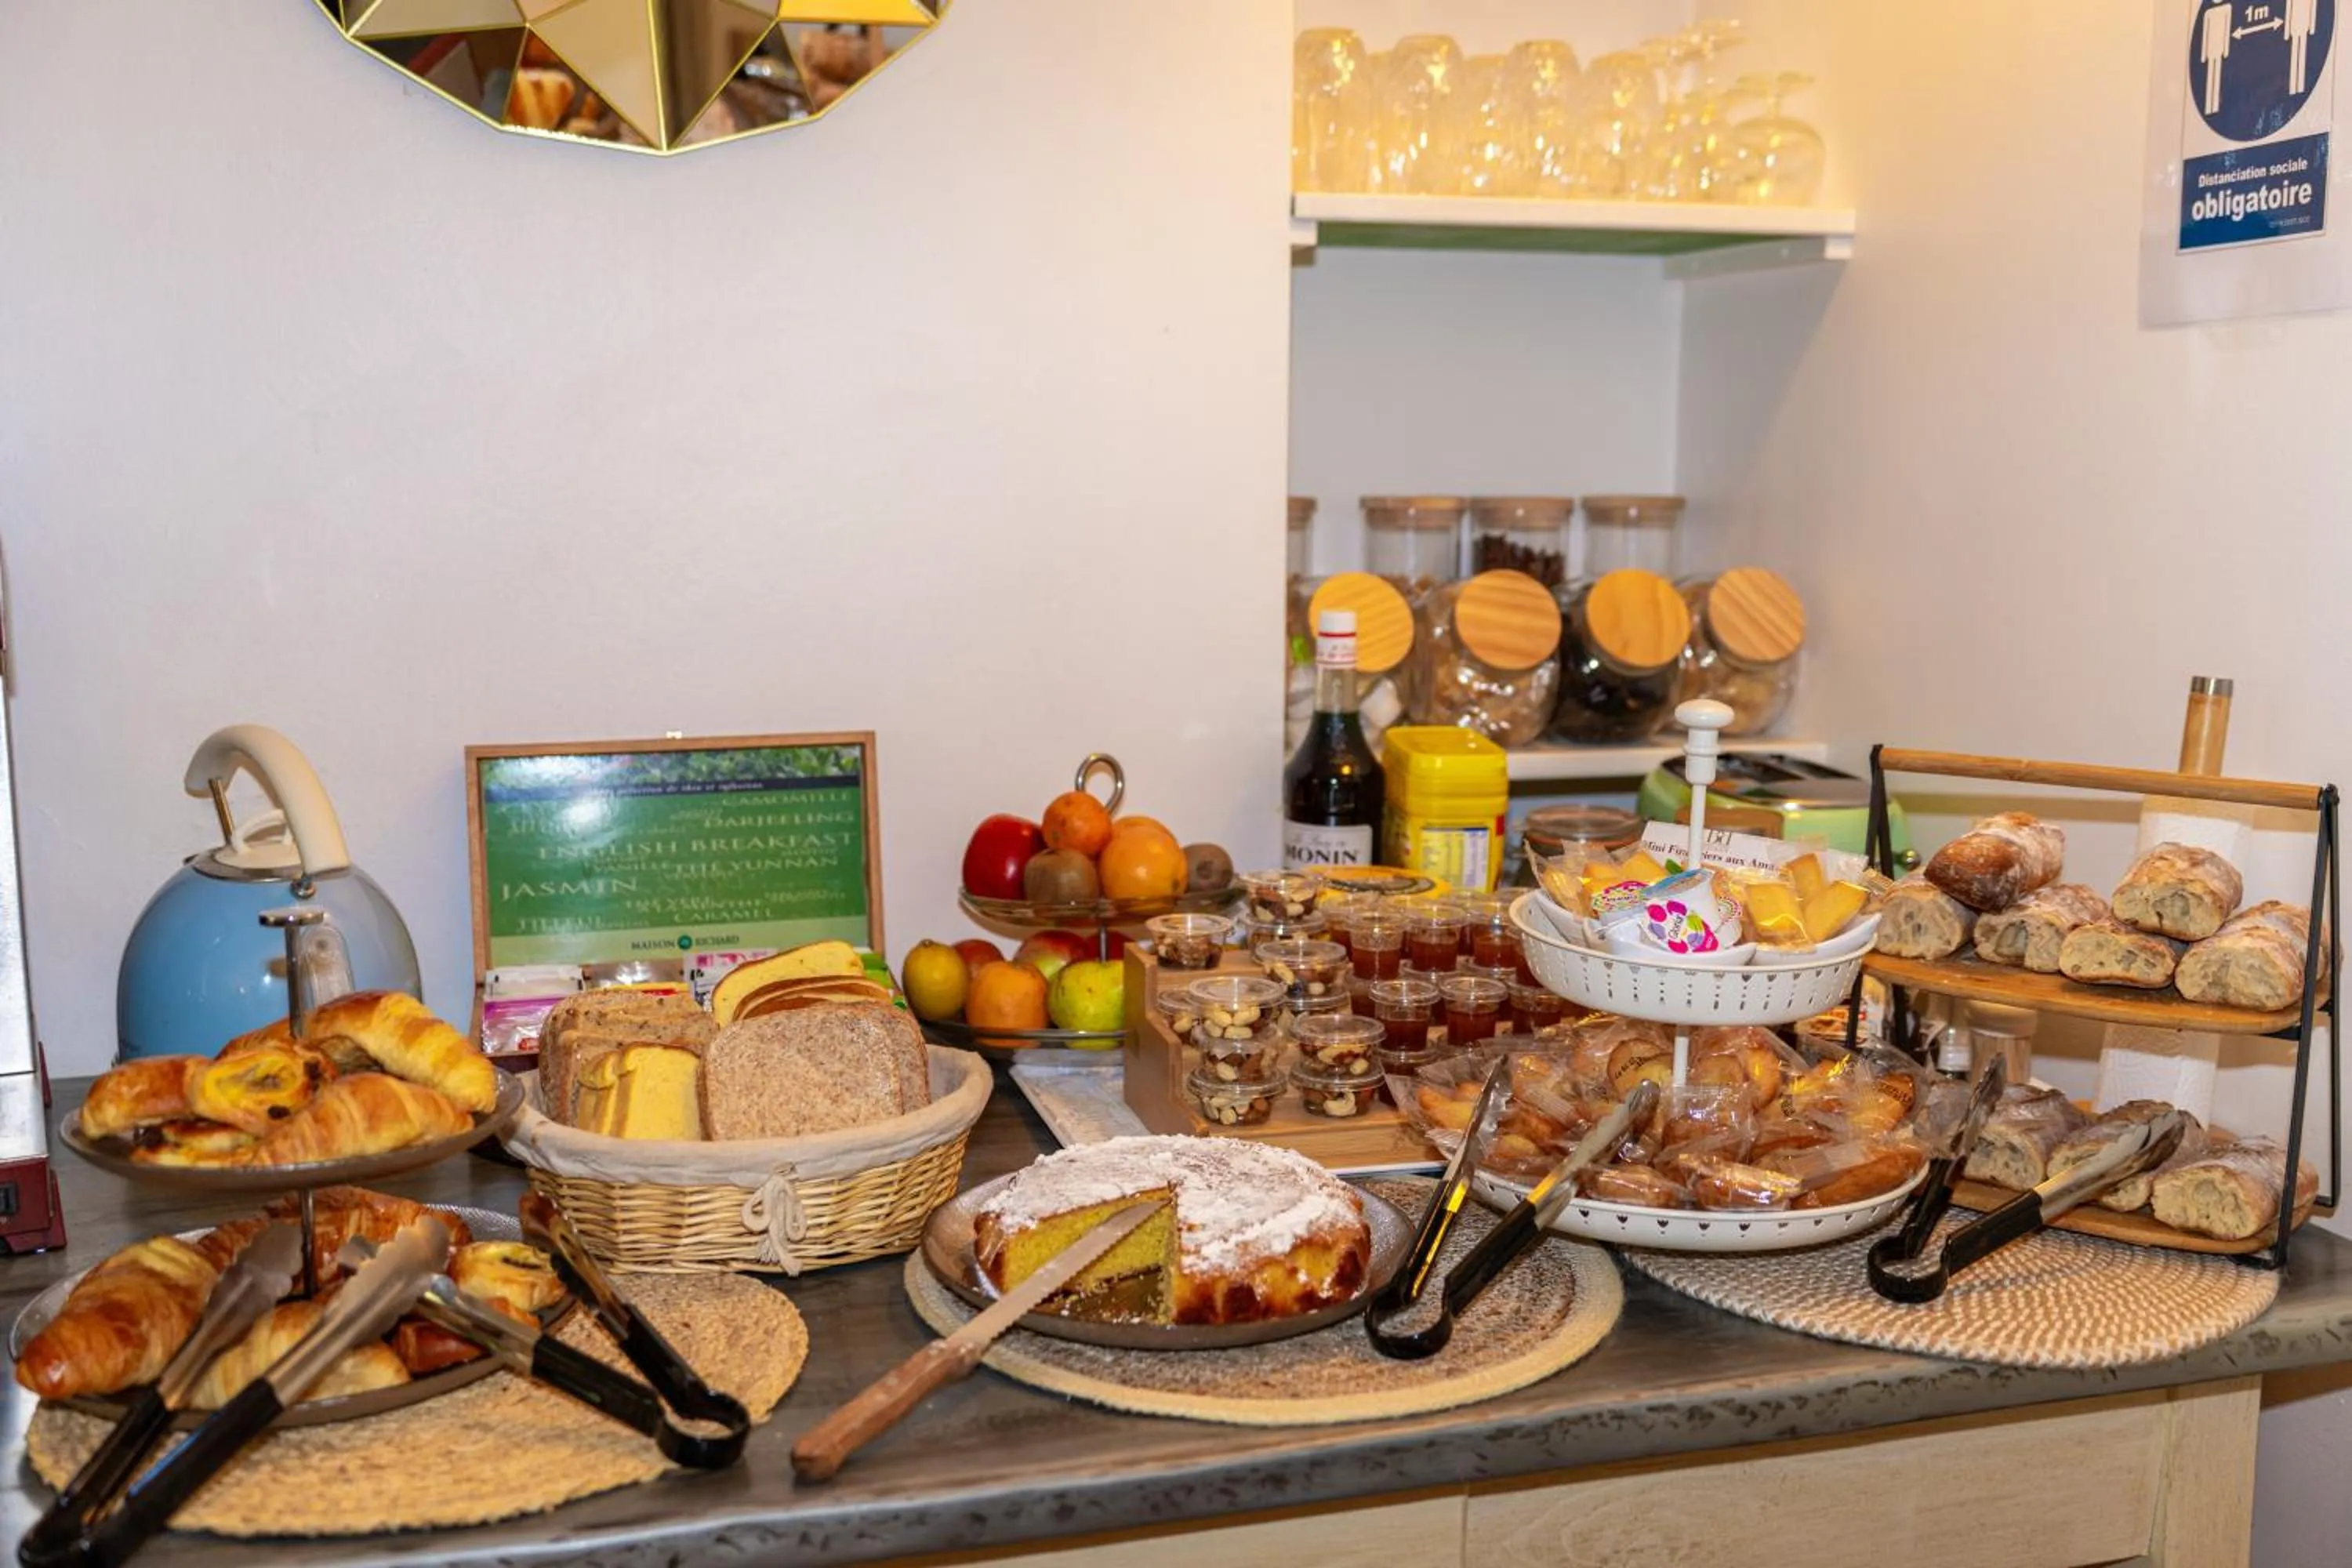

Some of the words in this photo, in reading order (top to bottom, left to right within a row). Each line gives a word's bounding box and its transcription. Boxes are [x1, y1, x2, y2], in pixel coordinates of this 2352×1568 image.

[2245, 5, 2269, 22] 1m
[2198, 165, 2267, 187] Distanciation
[2270, 157, 2308, 175] sociale
[2191, 180, 2313, 222] obligatoire
[704, 811, 855, 829] DARJEELING
[691, 832, 857, 852] BREAKFAST
[730, 856, 839, 871] YUNNAN
[1284, 844, 1359, 865] MONIN
[502, 877, 637, 901] JASMIN
